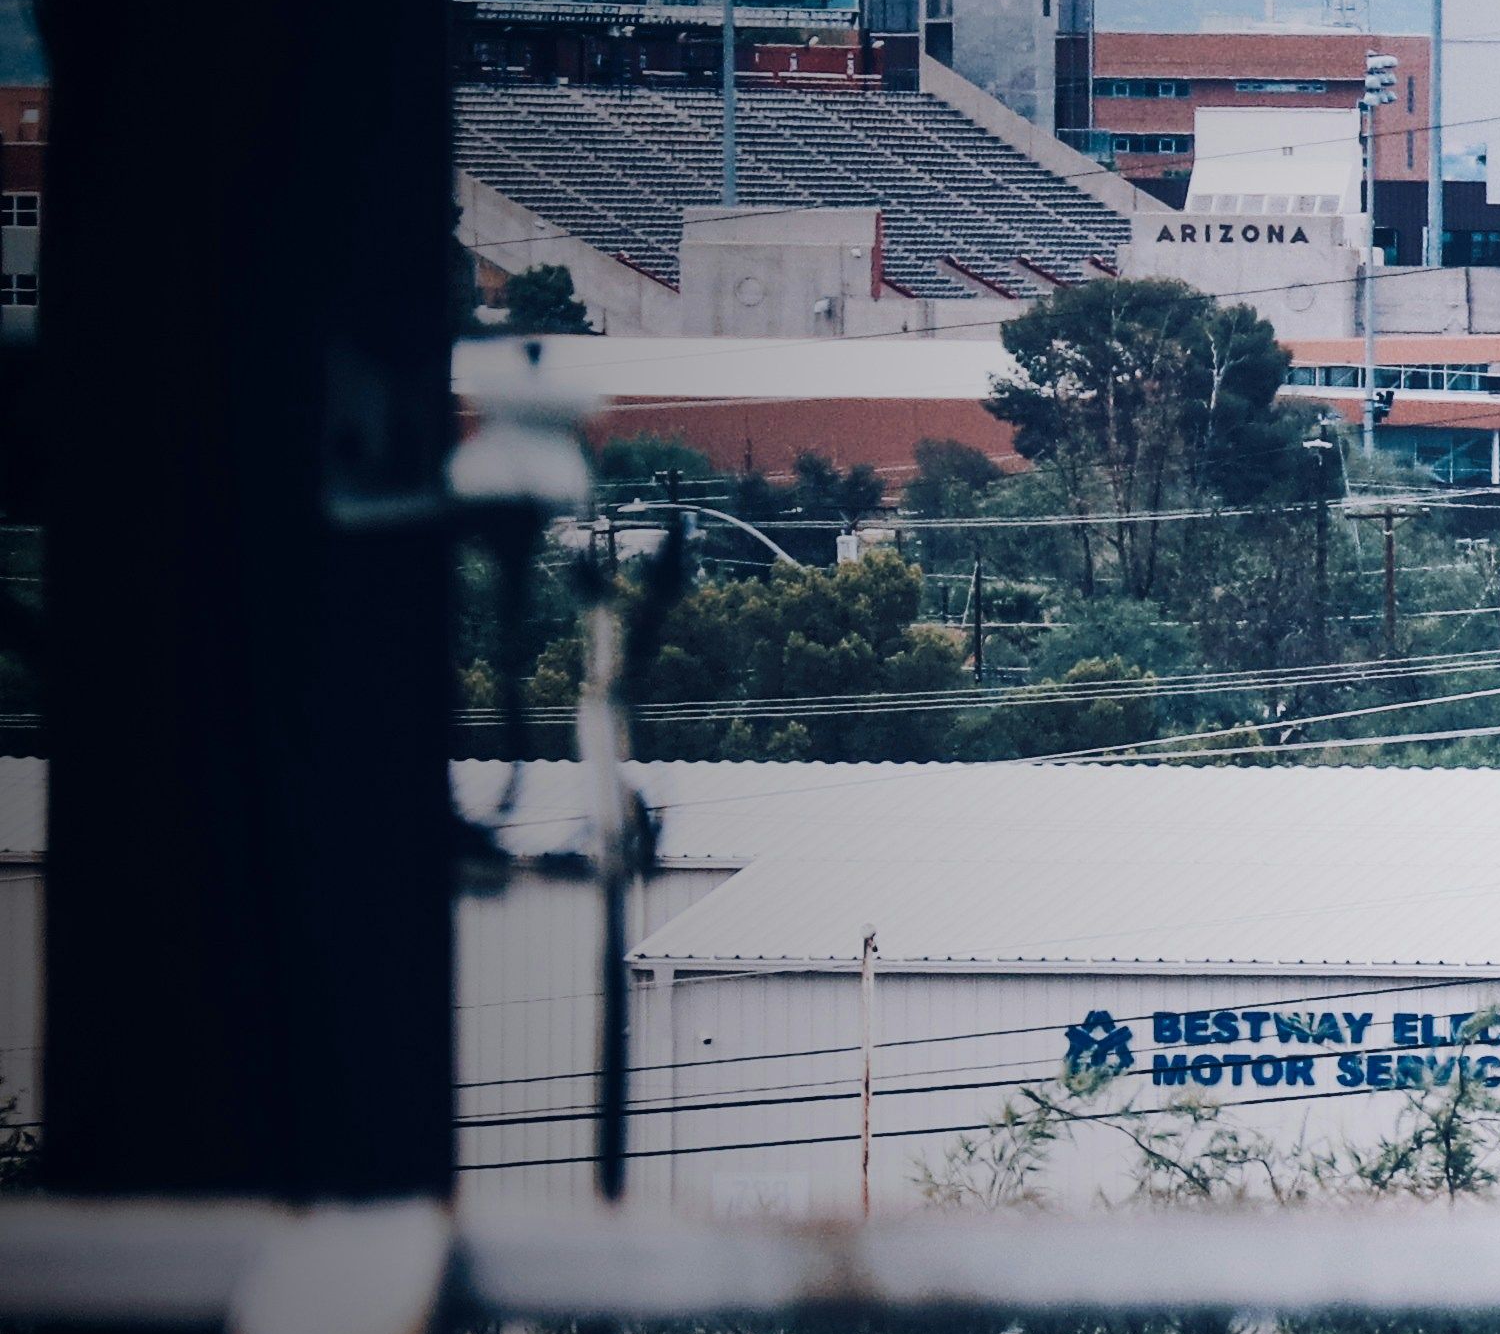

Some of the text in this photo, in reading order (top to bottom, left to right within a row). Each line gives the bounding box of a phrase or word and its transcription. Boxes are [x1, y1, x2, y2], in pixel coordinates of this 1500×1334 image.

[1156, 224, 1310, 243] ARIZONA
[1153, 1011, 1373, 1044] BESTWAY
[1152, 1054, 1315, 1087] MOTOR
